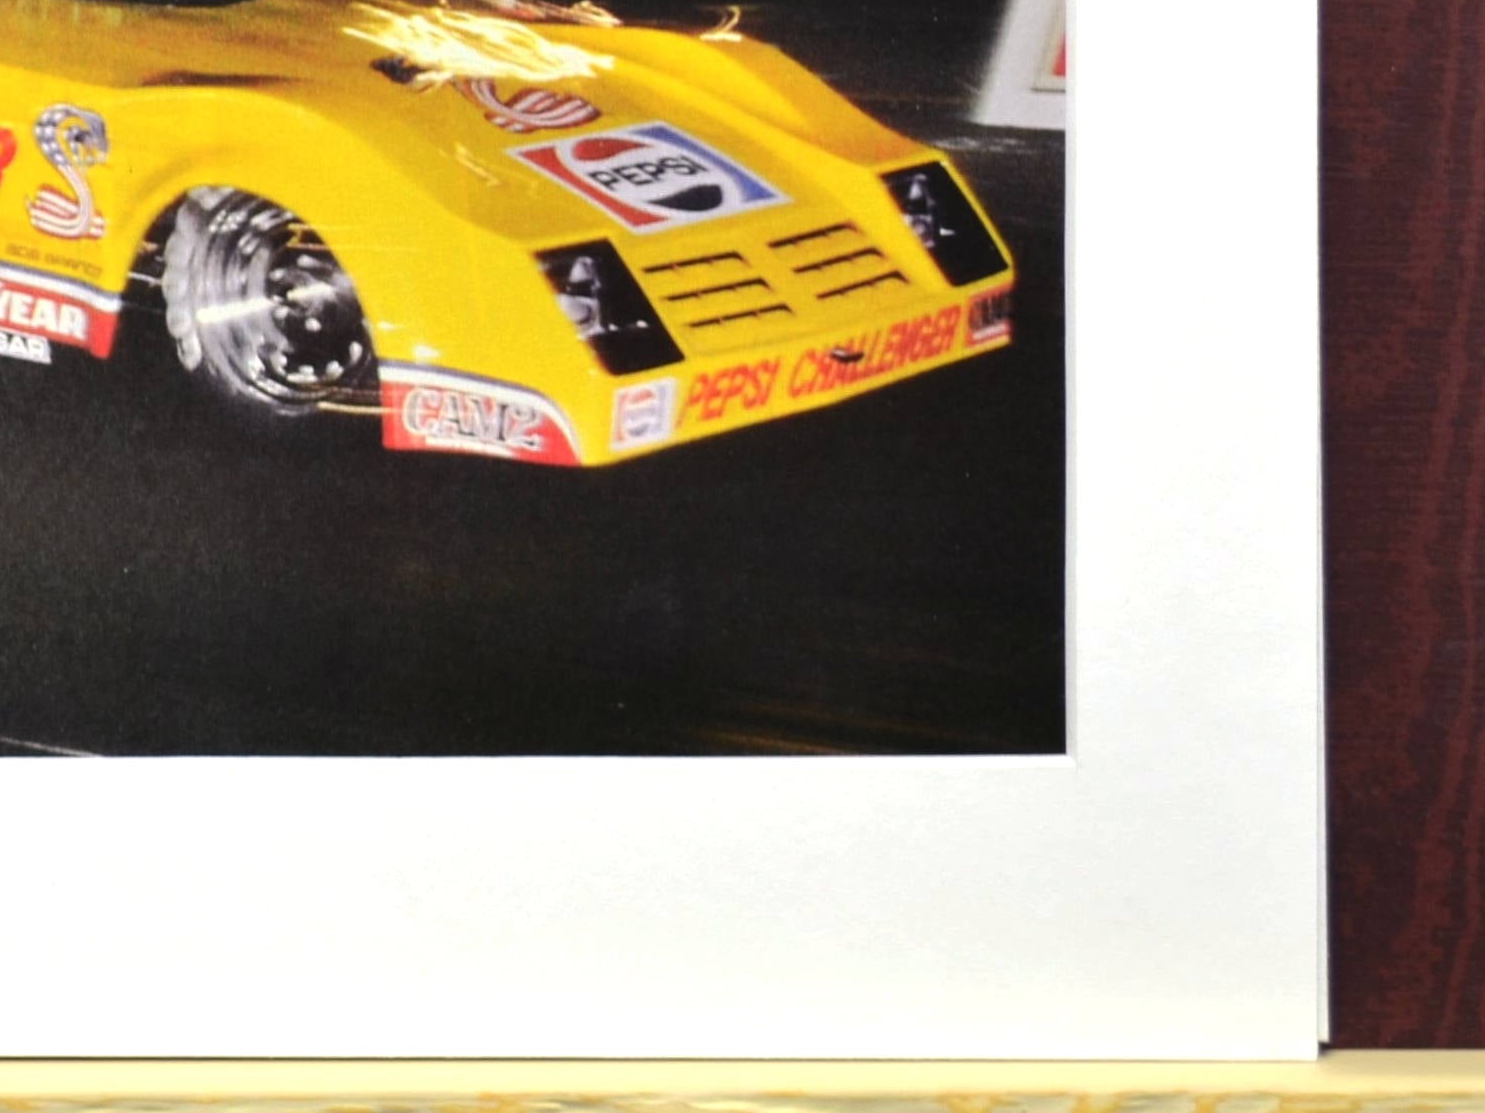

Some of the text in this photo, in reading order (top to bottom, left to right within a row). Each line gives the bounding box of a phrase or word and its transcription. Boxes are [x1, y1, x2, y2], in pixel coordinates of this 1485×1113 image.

[588, 155, 709, 191] PEPSI
[677, 358, 783, 427] PEPSI
[786, 304, 962, 399] CHALLENGER
[402, 388, 543, 452] CAM2
